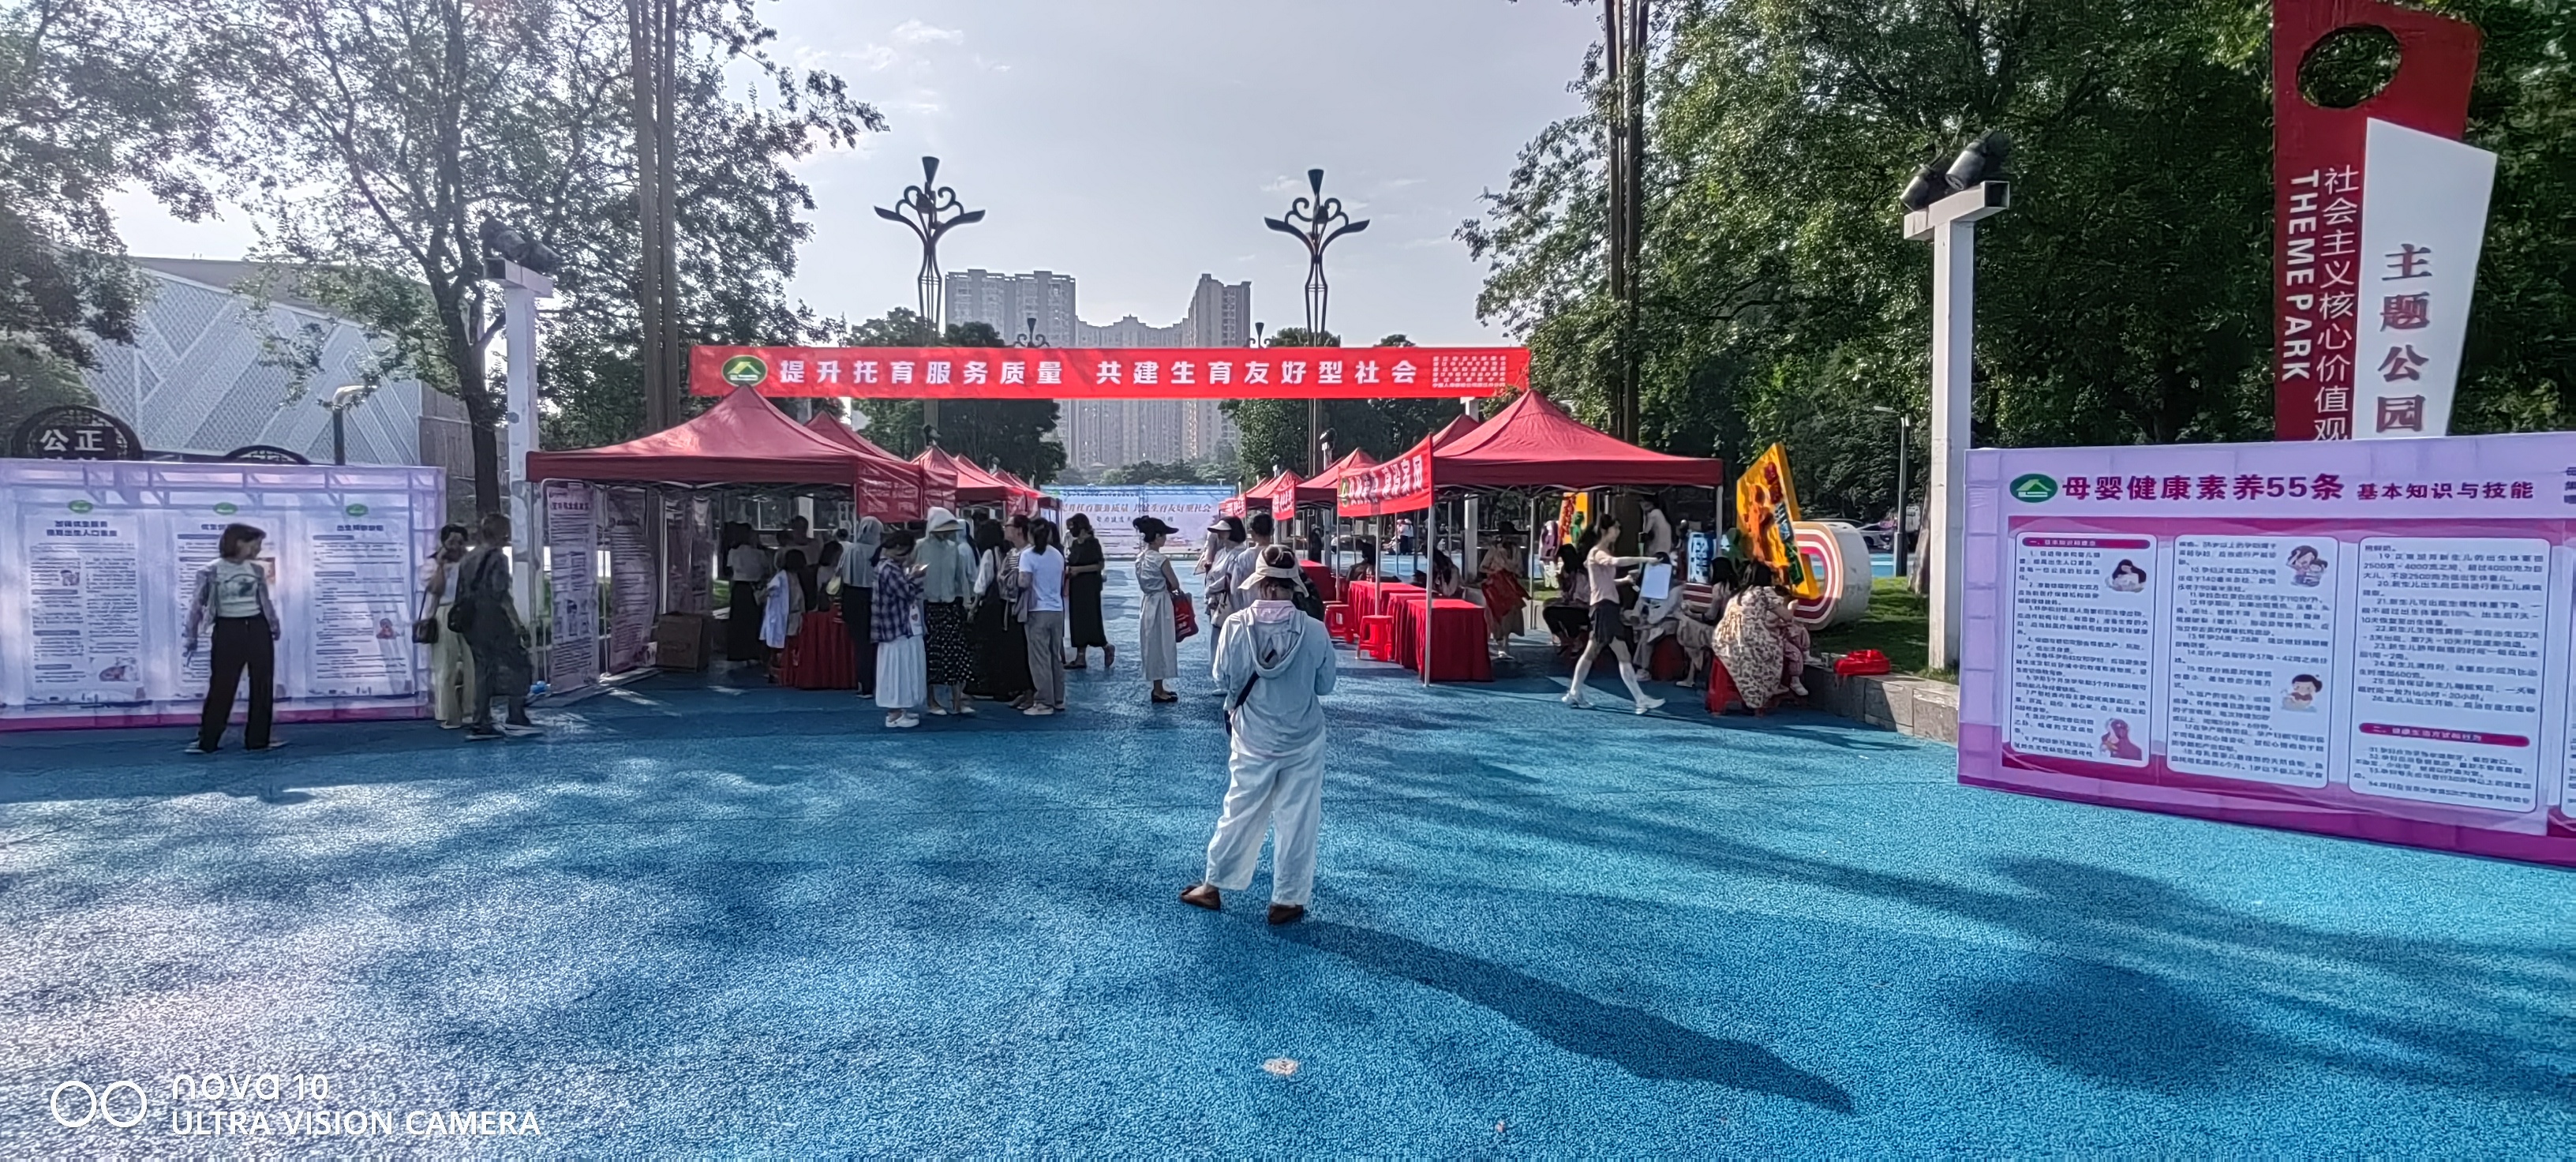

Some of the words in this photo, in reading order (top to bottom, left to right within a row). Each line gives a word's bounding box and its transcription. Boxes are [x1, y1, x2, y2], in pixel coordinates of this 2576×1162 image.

[2286, 170, 2320, 287] THEME
[2282, 294, 2314, 381] PARK
[2314, 164, 2359, 440] 社会主义核心价值观
[2376, 243, 2432, 433] 主题公园
[780, 360, 1062, 385] 提升托育服务质量
[1096, 360, 1417, 384] 共建生育友好型社会
[40, 429, 105, 452] 公正
[2062, 473, 2344, 502] 母婴健康素养55条
[2357, 480, 2534, 500] 基本知识与技能
